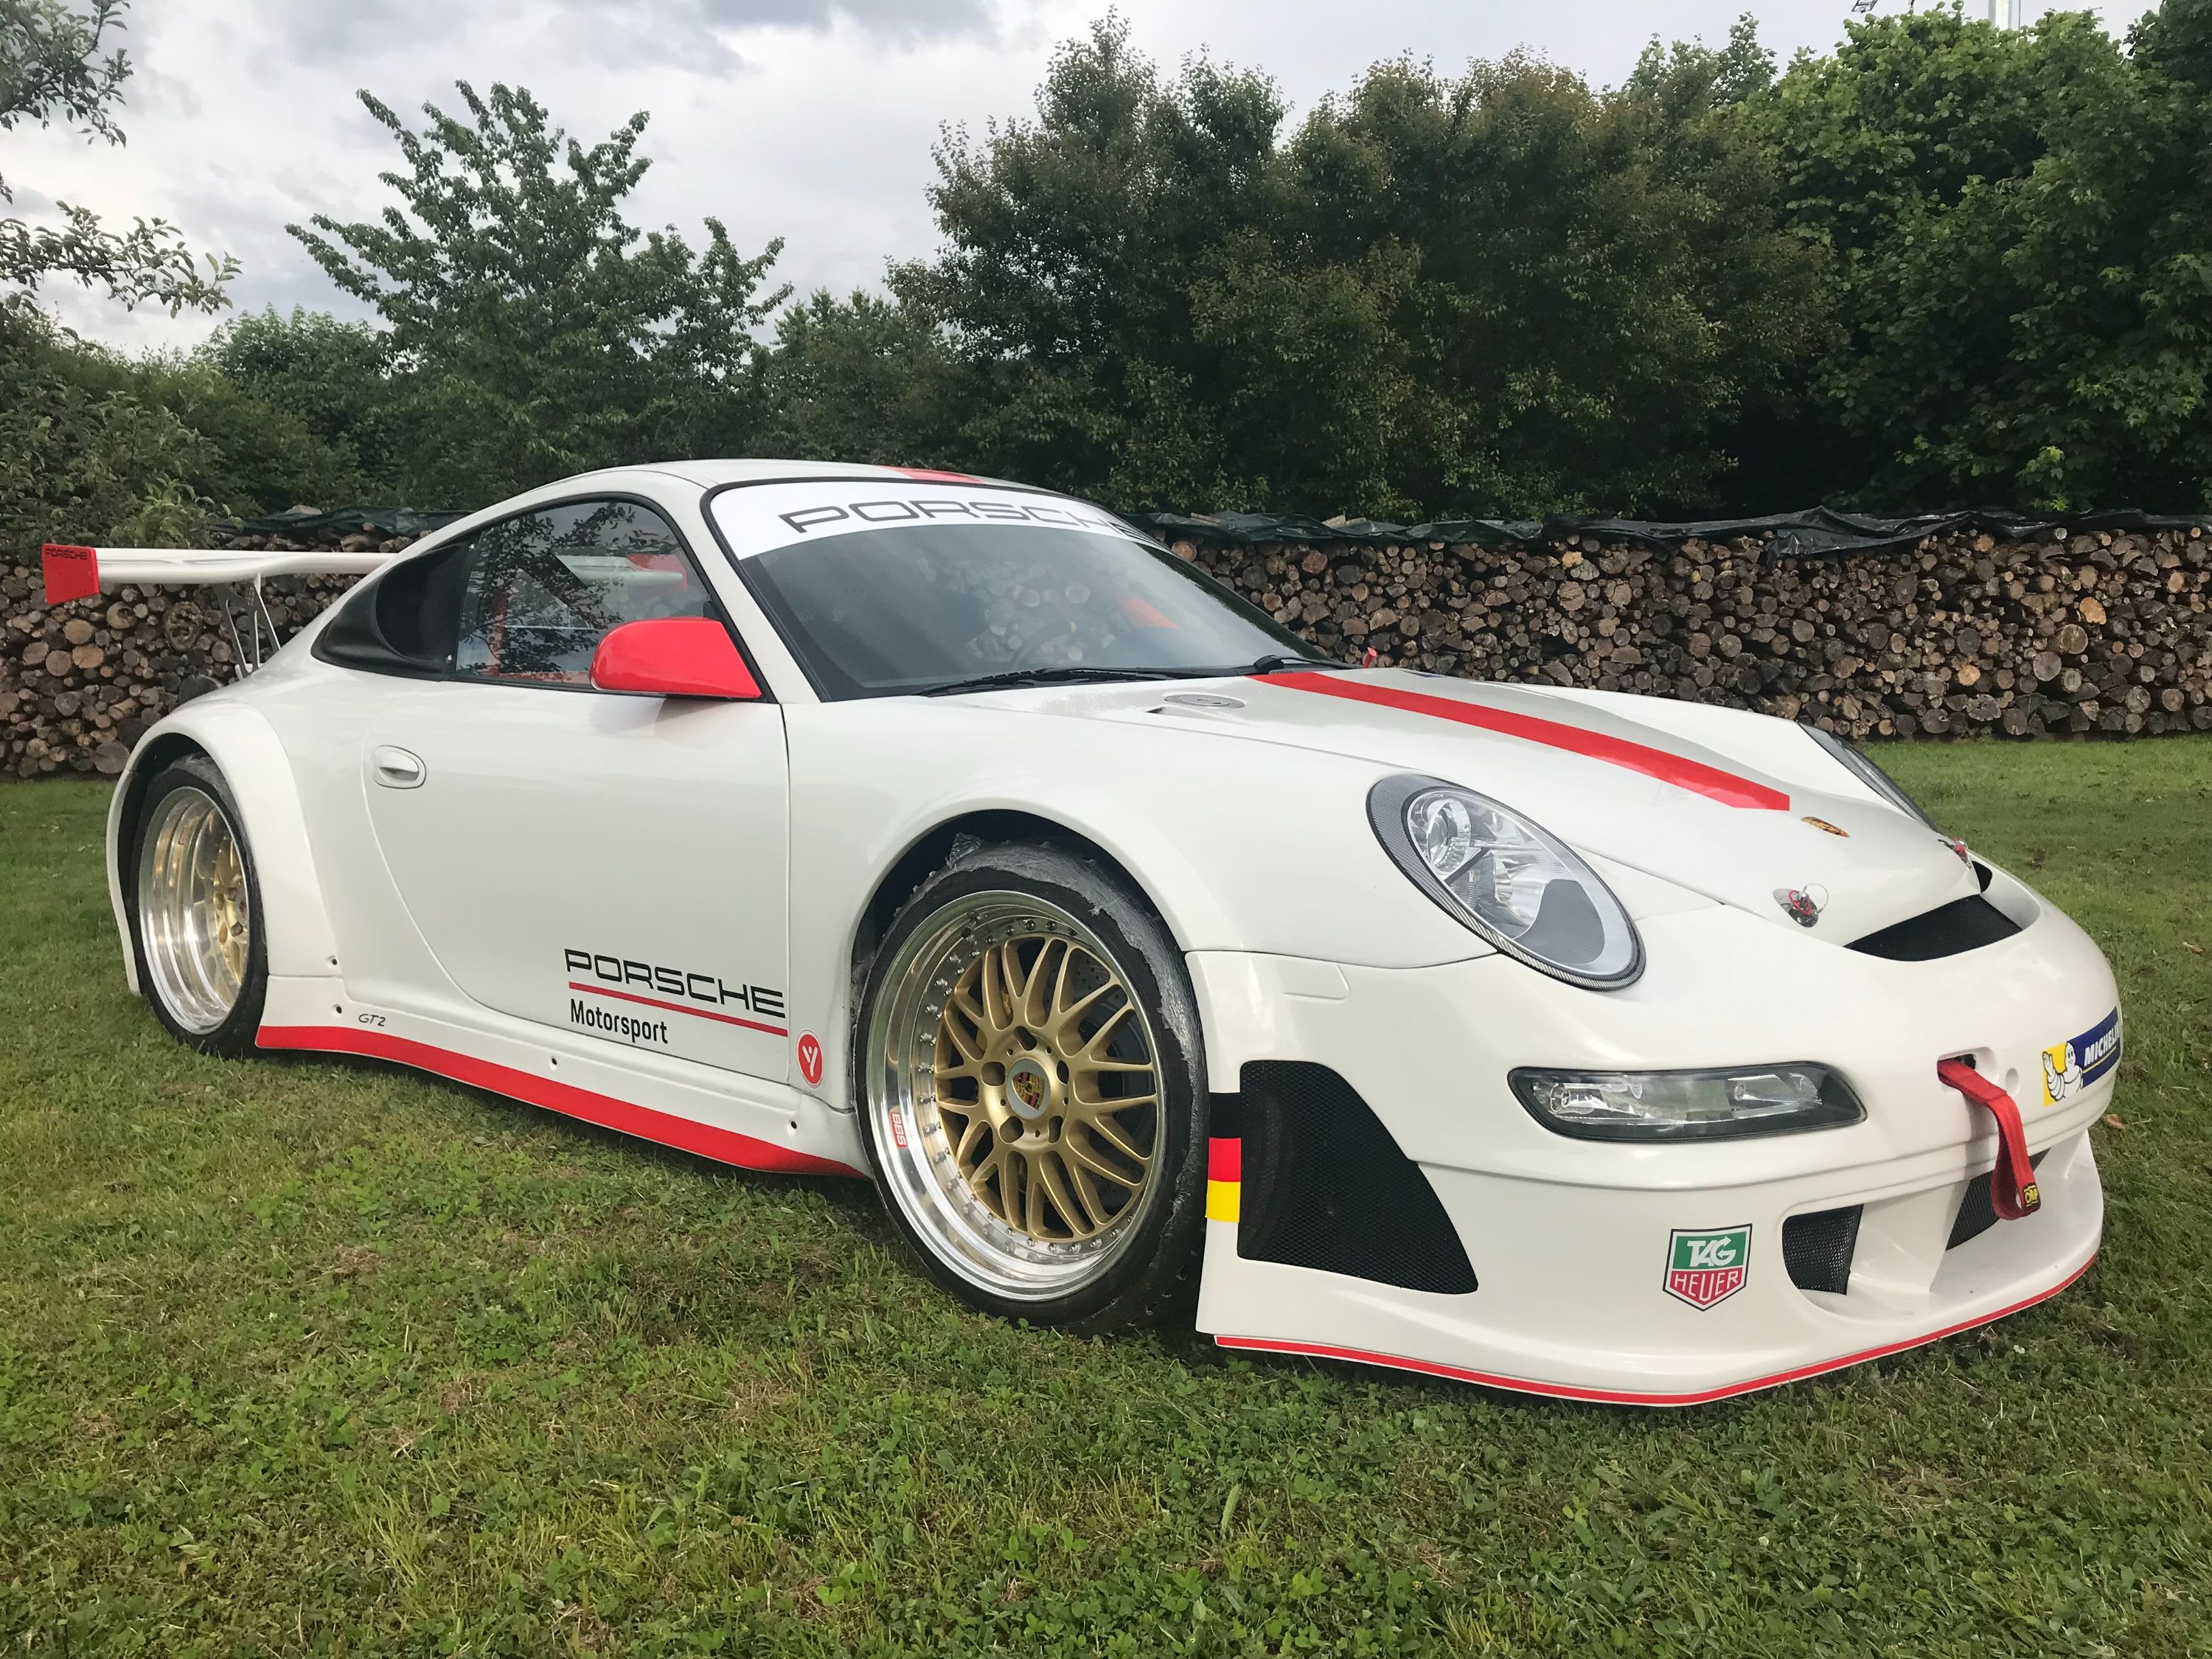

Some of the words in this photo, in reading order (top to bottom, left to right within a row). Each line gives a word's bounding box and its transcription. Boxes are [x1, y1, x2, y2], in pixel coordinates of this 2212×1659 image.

[779, 500, 1163, 549] PORSCHE
[46, 548, 88, 560] PORSCHE
[565, 949, 786, 1019] PORSCHE
[358, 1013, 386, 1026] GT2
[571, 998, 669, 1044] Motorsport
[891, 1113, 907, 1145] BBS
[1687, 1237, 1736, 1267] TAG
[1674, 1270, 1739, 1301] HEUER
